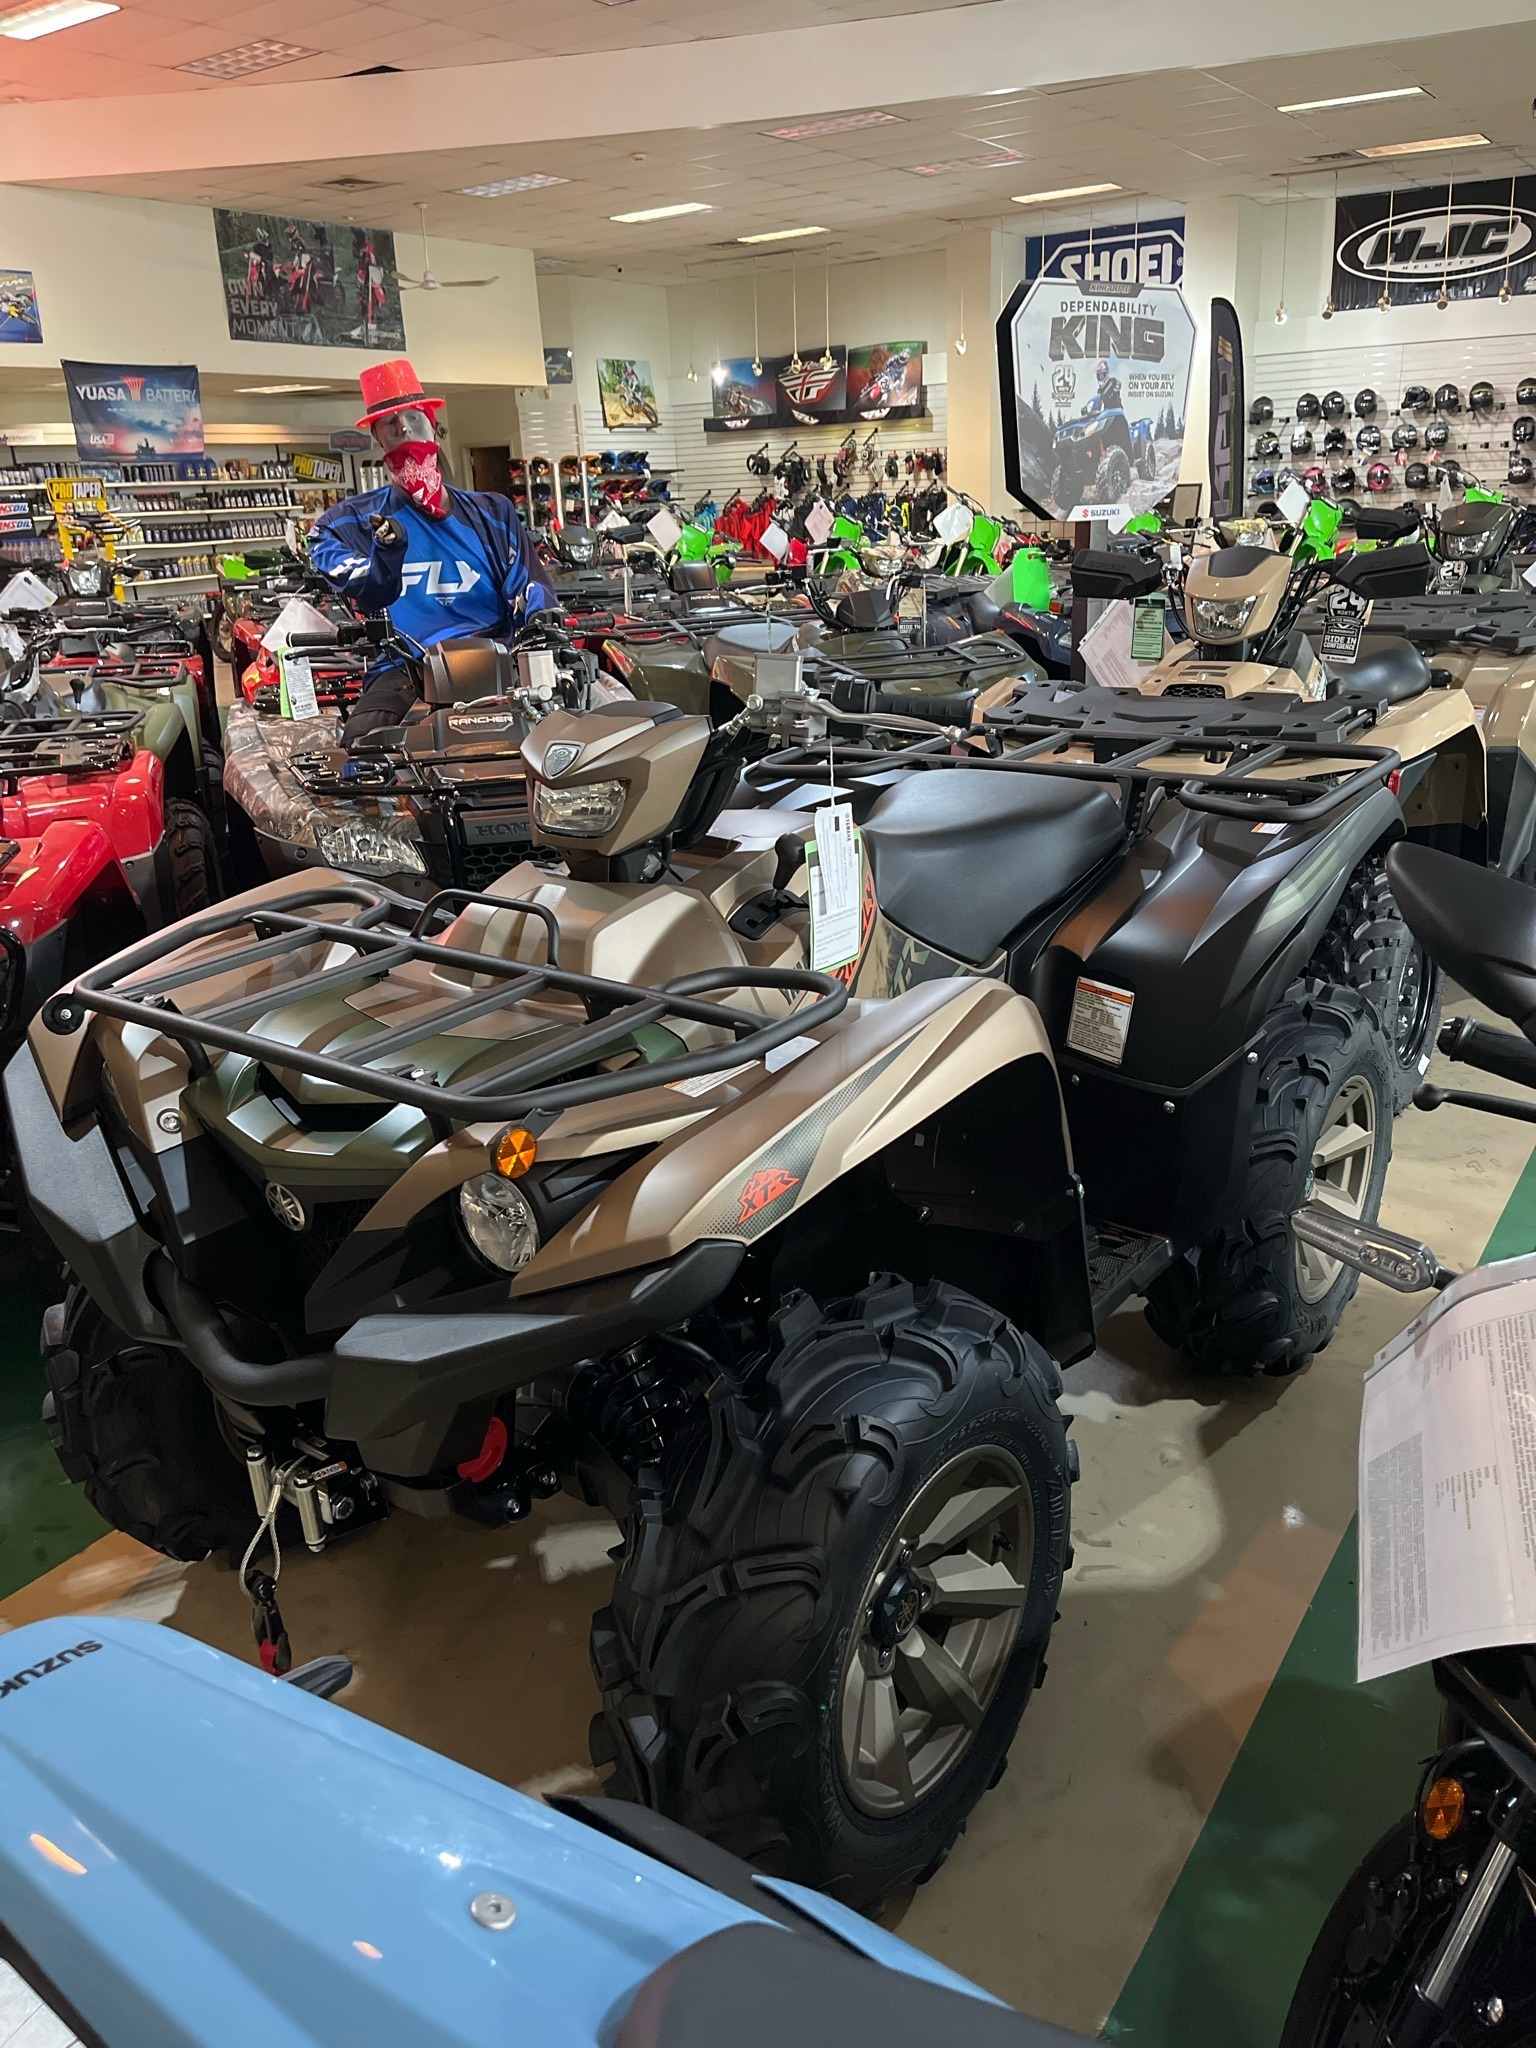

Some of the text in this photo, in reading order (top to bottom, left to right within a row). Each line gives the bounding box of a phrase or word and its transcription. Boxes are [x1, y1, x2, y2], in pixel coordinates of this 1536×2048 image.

[1366, 217, 1520, 268] HJC
[1060, 243, 1173, 284] SHOEI
[1402, 258, 1475, 271] HELMETS
[230, 298, 278, 317] EVERY
[1060, 300, 1157, 316] DEPENDABILITY
[232, 318, 297, 339] MOMENT
[1049, 314, 1165, 363] KING
[76, 386, 196, 402] YUASA BATTERY
[1128, 382, 1139, 390] ON
[1140, 382, 1160, 390] YOUR
[90, 434, 106, 445] USA
[294, 454, 342, 484] PROTAPER
[52, 482, 100, 499] PROTAPER
[0, 504, 28, 514] MSOIL
[1441, 560, 1466, 576] 24
[1331, 584, 1366, 612] 24
[1323, 642, 1356, 650] CONFIDENCE
[1325, 634, 1346, 644] RIDE
[448, 716, 514, 728] RANCHER
[474, 821, 530, 838] HON
[0, 1640, 104, 1698] SUZUK
